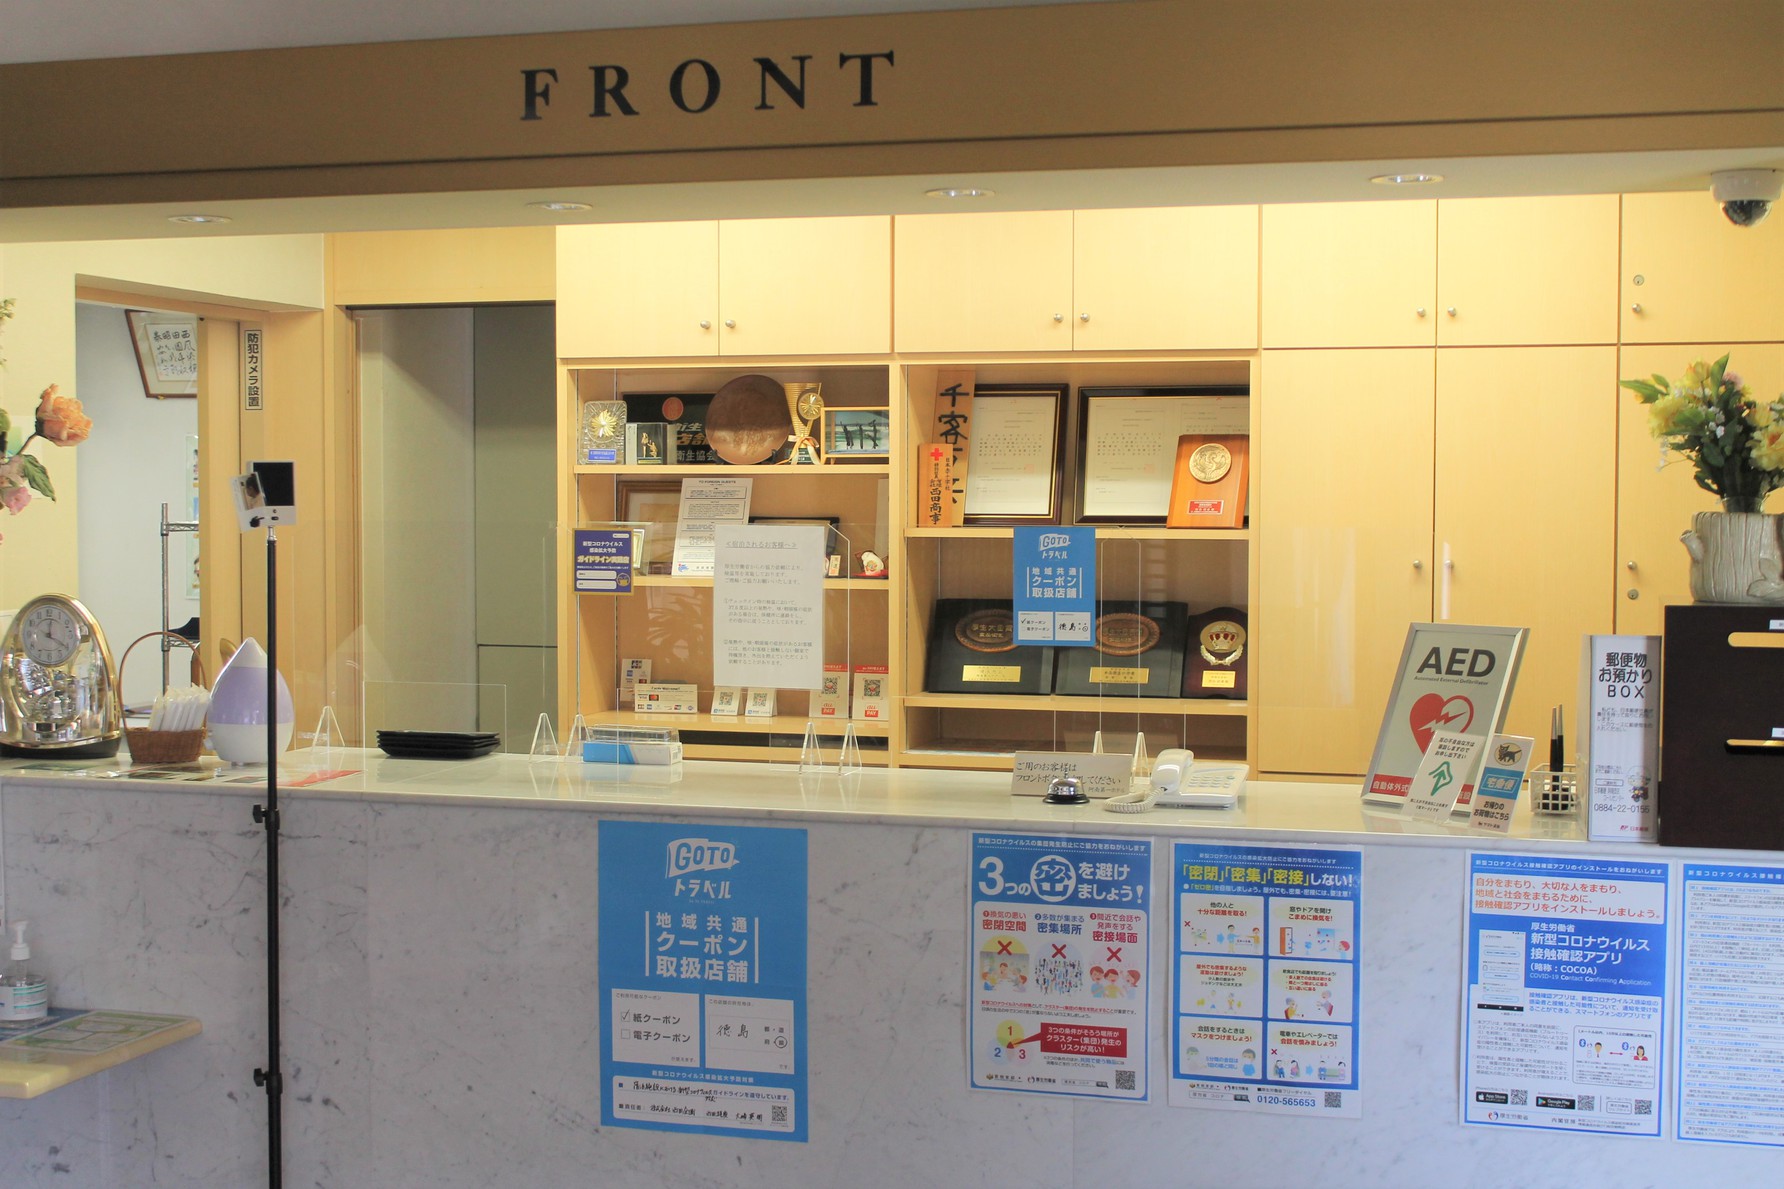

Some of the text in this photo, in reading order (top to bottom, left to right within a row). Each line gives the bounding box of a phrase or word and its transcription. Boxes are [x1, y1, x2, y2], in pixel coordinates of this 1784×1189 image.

[520, 50, 895, 121] FRONT
[247, 333, 260, 407] 防犯カメラ設置
[1042, 551, 1068, 559] トラベル
[1032, 567, 1077, 576] 地域共通
[1032, 576, 1077, 586] クーポン
[1032, 587, 1077, 598] 取扱店舗
[1417, 646, 1496, 678] AED
[1606, 652, 1647, 668] 郵便物
[1599, 667, 1652, 684] お預かり
[1607, 685, 1644, 698] BOX
[1016, 762, 1077, 772] ご用のお客様は
[1487, 777, 1516, 790] 宅急便
[1484, 801, 1504, 809] お帰りの
[1473, 809, 1509, 820] お荷物はこちら
[1078, 862, 1131, 881] を避け
[674, 879, 731, 899] トラベル
[1476, 877, 1623, 894] 自分をまもり、大切な人をまもり、
[1475, 889, 1594, 904] 地域と社会をまもるために、
[1289, 906, 1332, 914] 窓やドアを開け
[1475, 899, 1661, 919] 接触確認アプリをインストールしましょう。
[656, 912, 748, 933] 地域共通
[982, 919, 1027, 932] 密閉空間
[1097, 922, 1133, 931] 発声をする
[1530, 922, 1575, 932] 厚生労働省
[1037, 923, 1082, 935] 密集場所
[1093, 931, 1138, 943] 密接場面
[1530, 932, 1650, 951] 新型コロナウイルス
[656, 931, 748, 956] クーポン
[1530, 947, 1623, 964] 接触確認アプリ
[656, 955, 748, 984] 取扱店舗
[1529, 972, 1652, 986] COVID-19 Contact Confirming Application
[633, 1013, 680, 1025] 紙クーポン
[1007, 1026, 1013, 1035] 1
[1048, 1027, 1119, 1037] 3つの条件がそろう場所が
[1197, 1025, 1245, 1034] 会話をするときは
[1279, 1030, 1338, 1040] 電車やエレベーターでは
[633, 1030, 691, 1042] 電子クーポン
[994, 1047, 1001, 1057] 2
[1018, 1050, 1026, 1059] 3
[1257, 1095, 1316, 1107] 0120-565653
